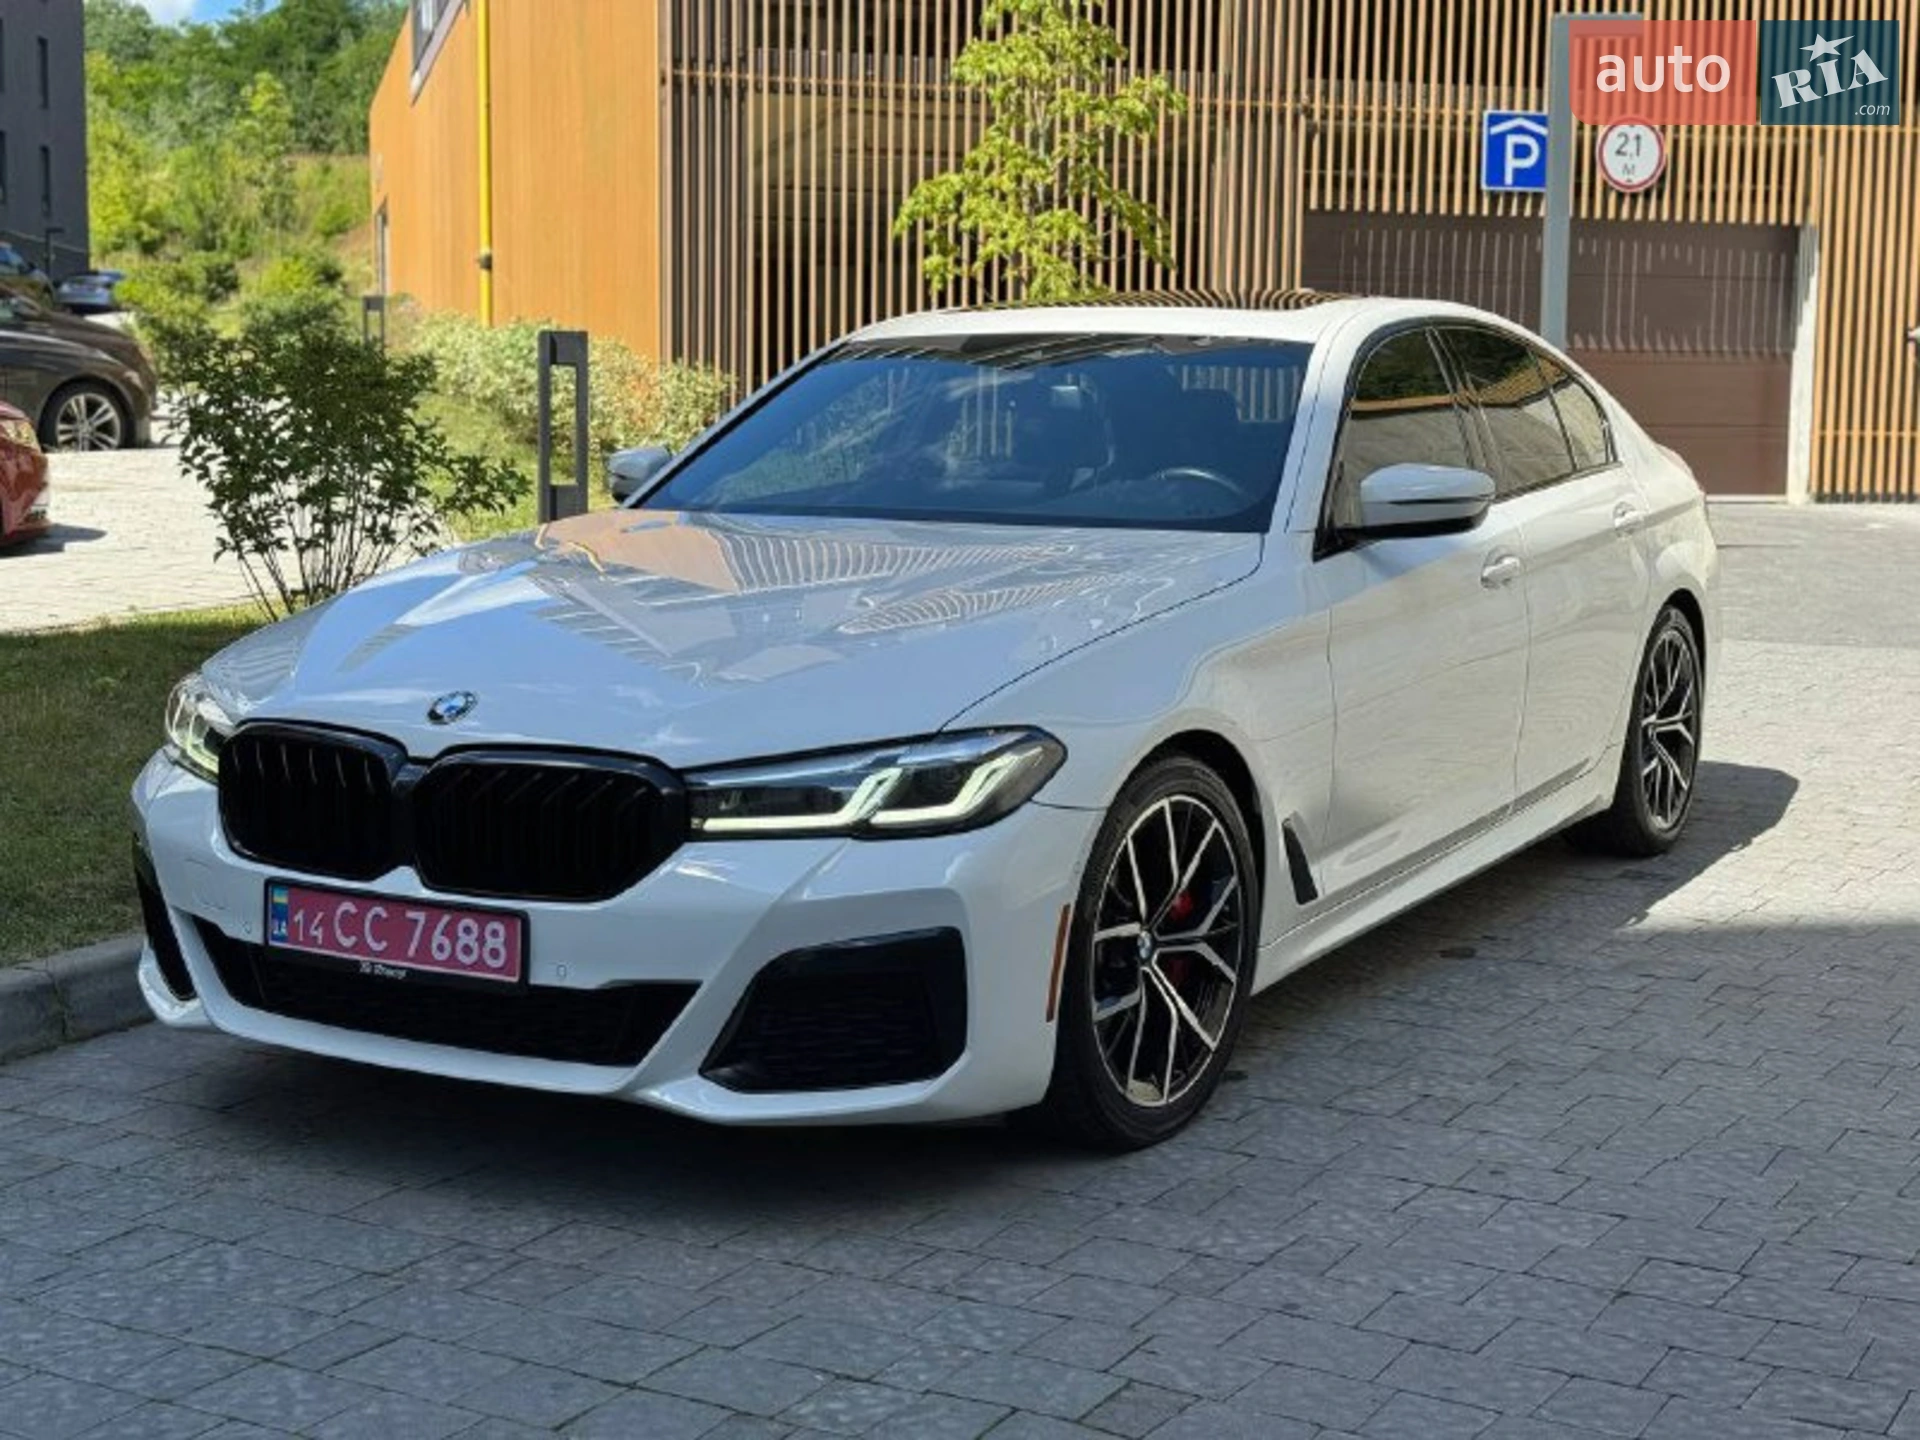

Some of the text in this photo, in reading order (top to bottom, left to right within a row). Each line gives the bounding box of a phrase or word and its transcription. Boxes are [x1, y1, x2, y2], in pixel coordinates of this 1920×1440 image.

[1503, 133, 1540, 186] P
[293, 901, 507, 969] 14 CC 7688
